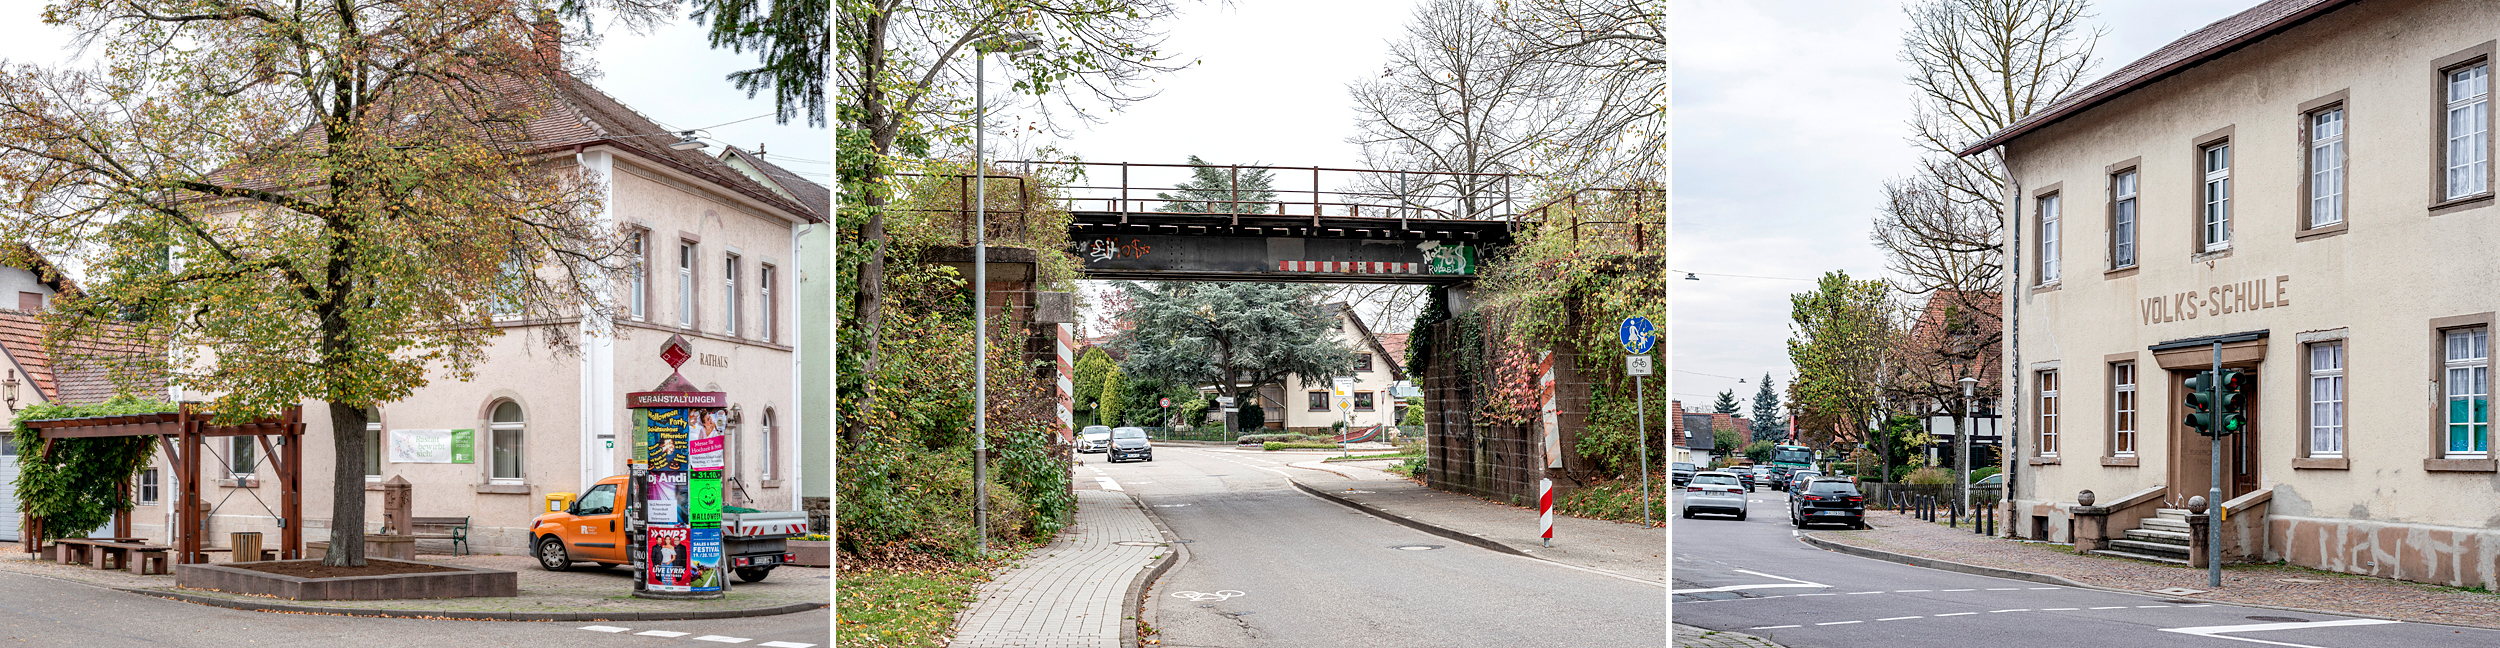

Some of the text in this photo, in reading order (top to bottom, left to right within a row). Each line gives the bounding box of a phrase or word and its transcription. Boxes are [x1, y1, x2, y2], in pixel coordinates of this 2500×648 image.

[2140, 274, 2290, 326] VOLKS-SCHULE
[700, 352, 728, 368] RATHAUS
[638, 395, 716, 404] VERANSTALTUNGEN
[647, 409, 679, 422] Halloween
[669, 417, 688, 430] Party
[415, 435, 440, 443] Rastatt
[416, 450, 433, 458] sich!
[691, 446, 711, 454] Hochzeit
[648, 472, 687, 484] Dj Andi
[666, 567, 686, 575] LYRIX
